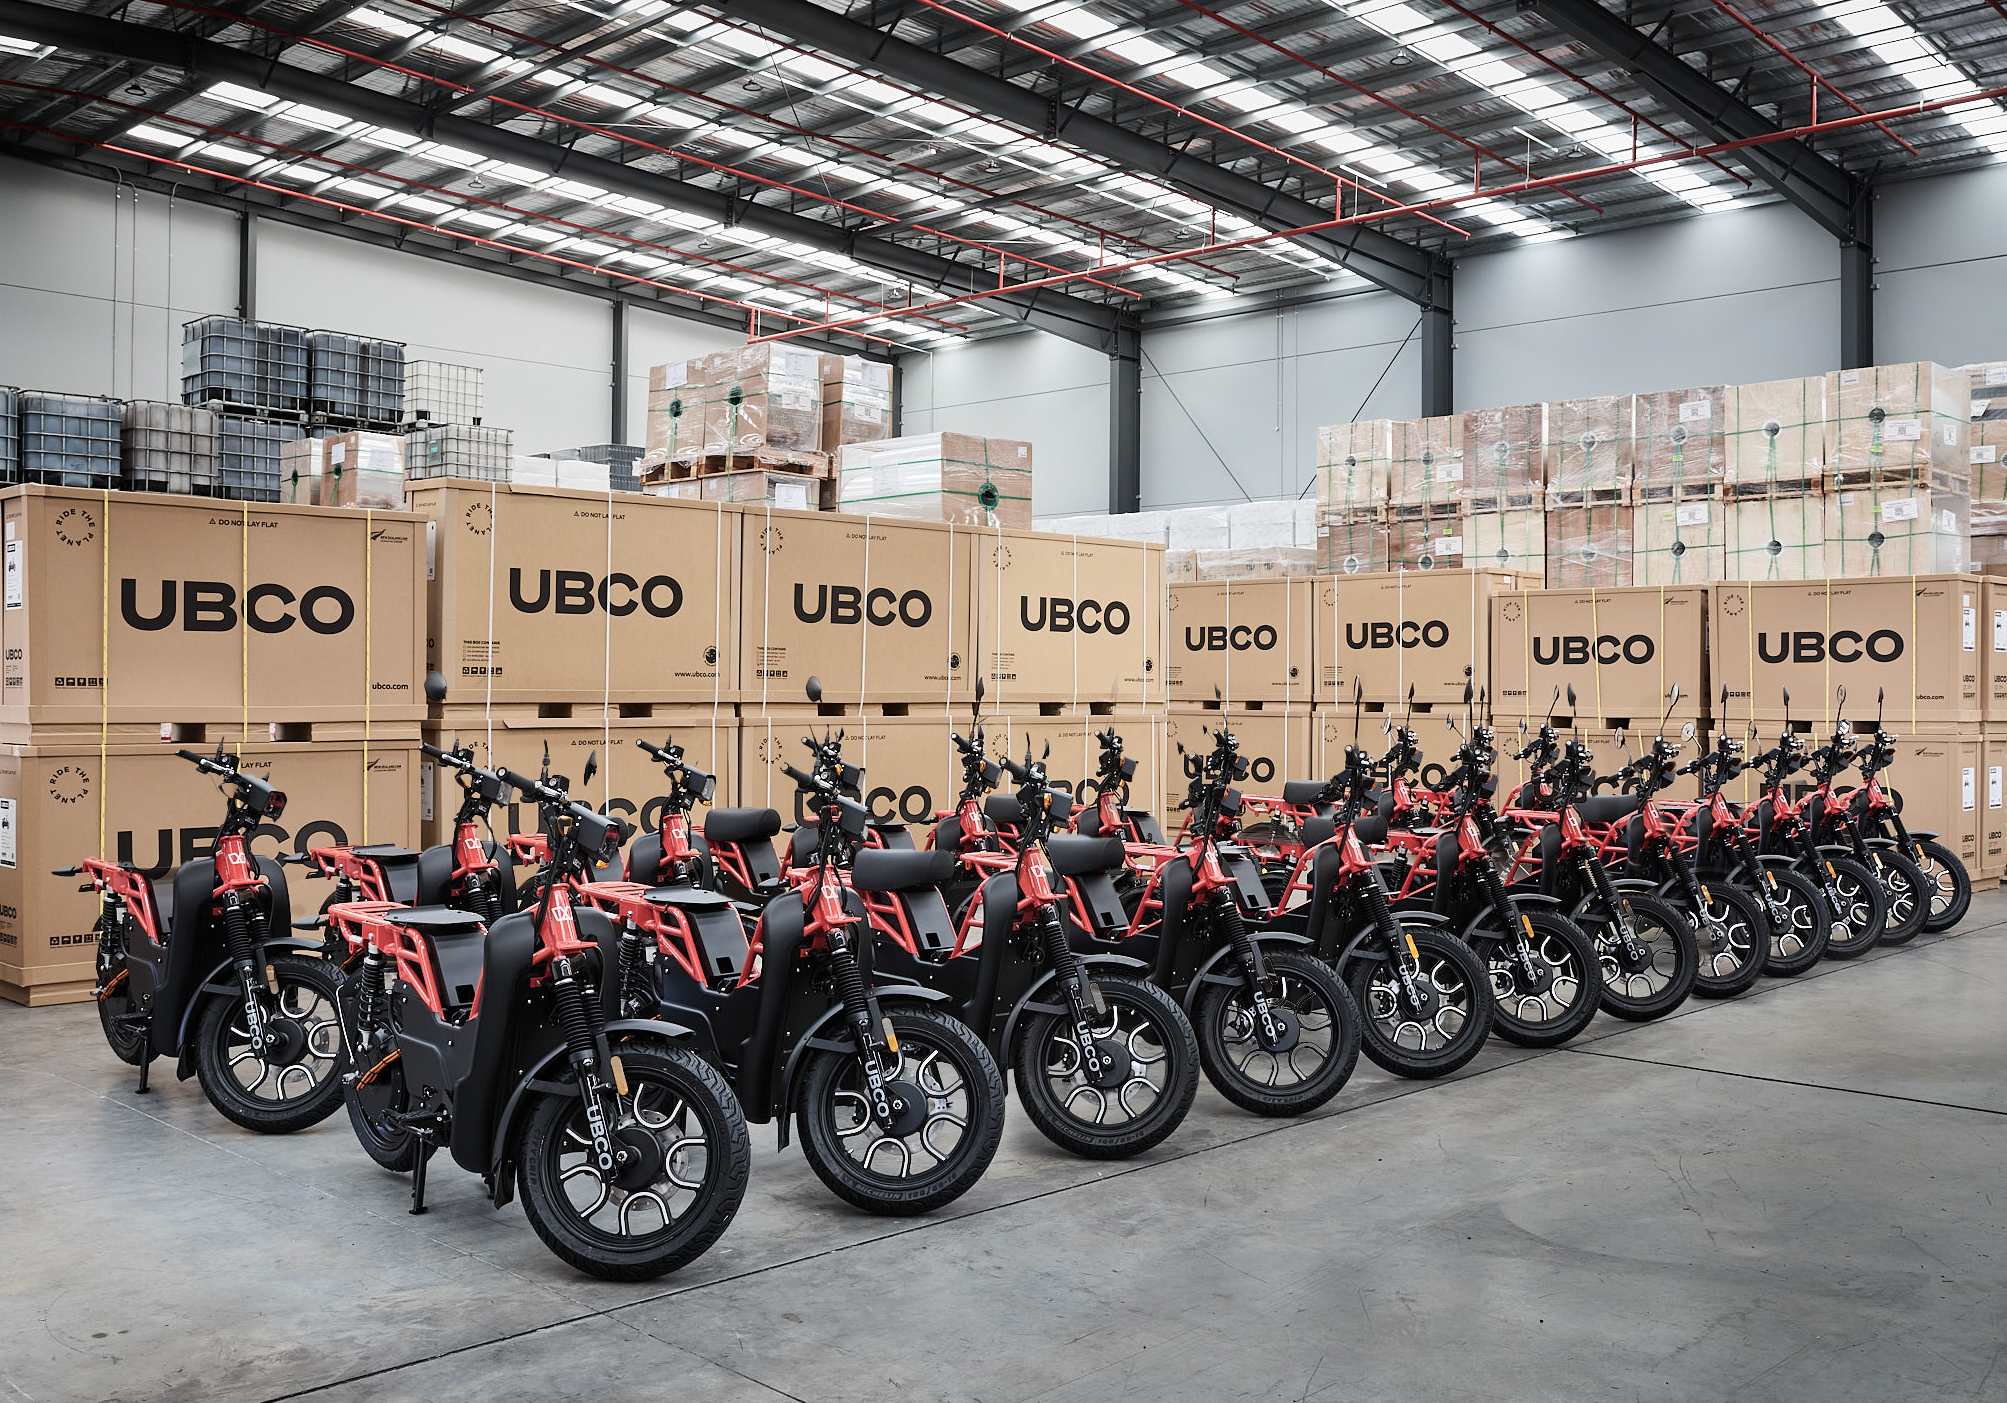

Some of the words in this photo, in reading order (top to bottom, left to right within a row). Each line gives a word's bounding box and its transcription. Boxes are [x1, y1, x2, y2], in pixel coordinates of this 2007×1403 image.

[56, 508, 76, 525] RIDE
[81, 510, 95, 527] THE
[465, 502, 481, 518] RIDE
[56, 532, 94, 546] PLANET
[121, 578, 355, 635] UBCO
[509, 567, 683, 618] UBCO
[794, 583, 932, 628] UBCO
[1020, 595, 1130, 635] UBCO
[1185, 624, 1278, 652] UBCO
[1346, 620, 1449, 649] UBCO
[1533, 634, 1655, 665] UBCO
[1758, 629, 1904, 664] UBCO
[6, 648, 22, 660] UBCO
[372, 682, 409, 690] ubco.com
[49, 766, 70, 784] RIDE
[75, 767, 90, 784] THE
[50, 788, 89, 804] PLANET
[795, 786, 932, 829] UCO
[1764, 893, 1782, 924] UBCO
[1619, 925, 1639, 961] UBCO
[1516, 943, 1537, 981] UBCO
[1398, 964, 1420, 1006] UBCO
[244, 1000, 263, 1050] UBCO
[1253, 990, 1275, 1037] UBCO
[1076, 1020, 1100, 1072] UBCO
[864, 1059, 890, 1118] UBCO
[586, 1103, 613, 1170] UBCO
[1054, 1119, 1094, 1143] MICHELIN
[855, 1182, 901, 1199] MICHELIN
